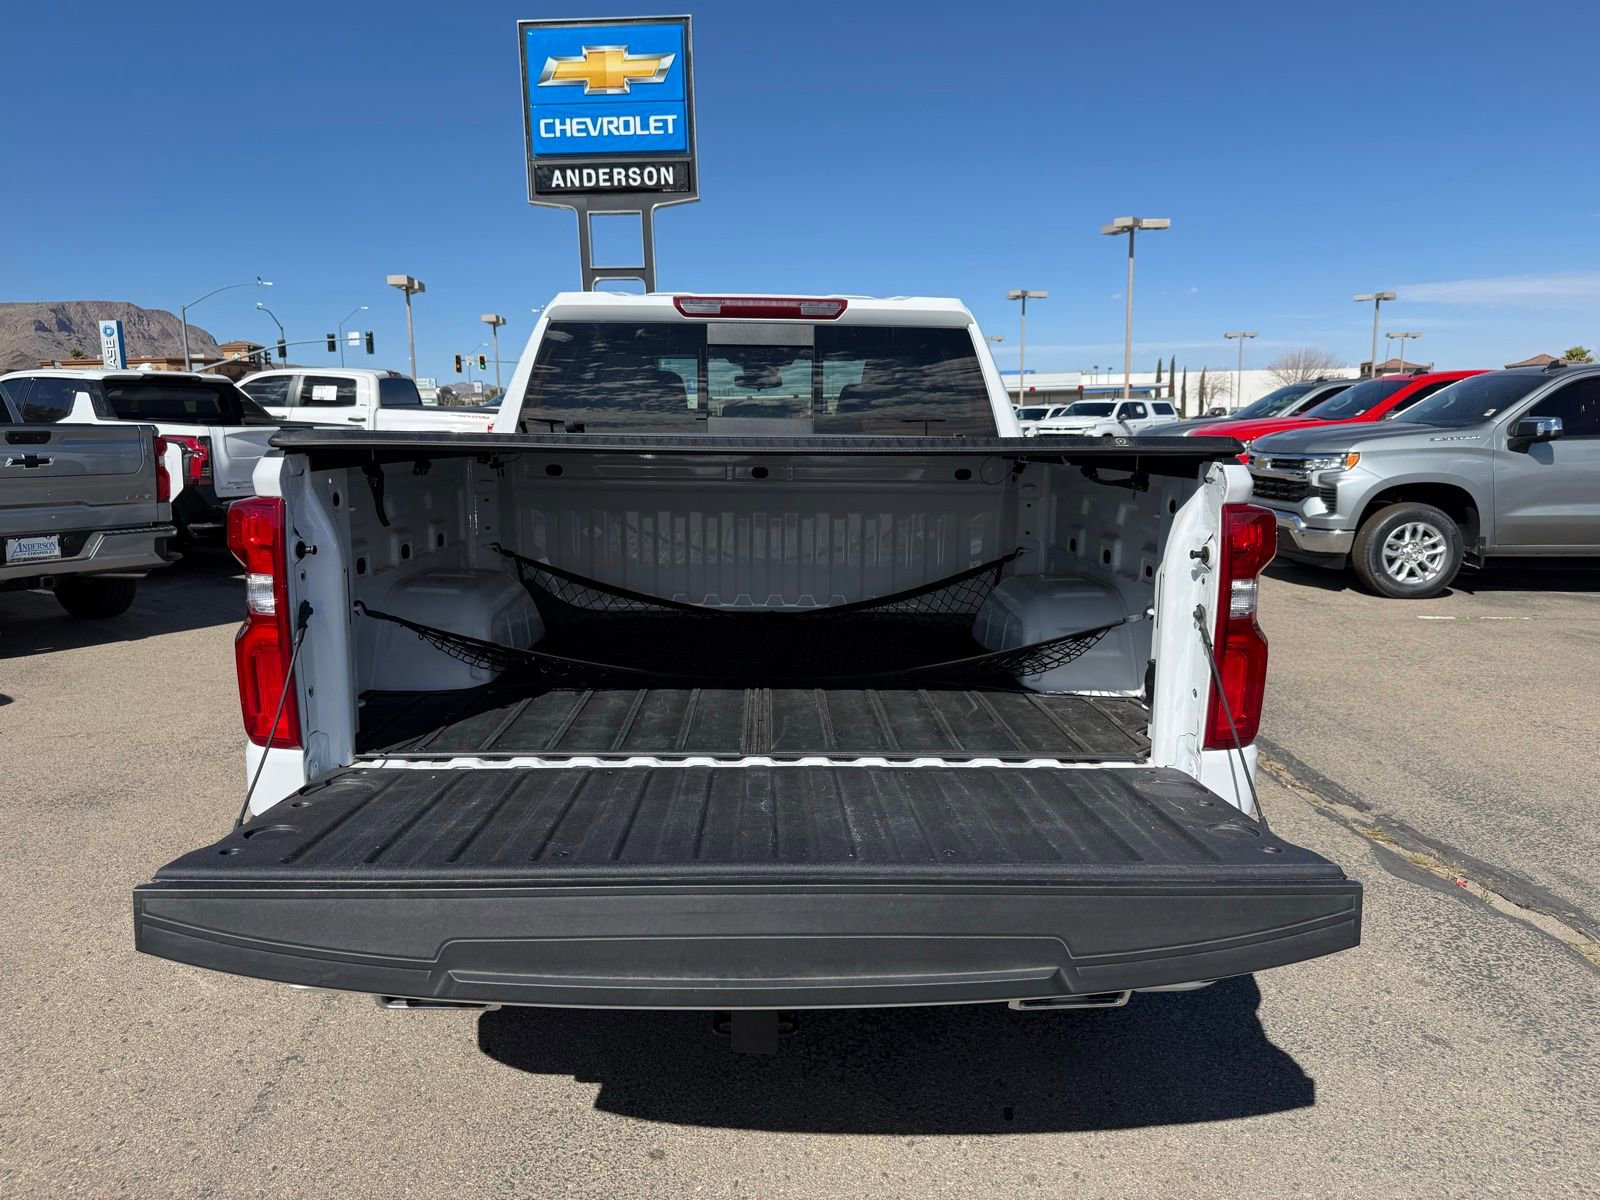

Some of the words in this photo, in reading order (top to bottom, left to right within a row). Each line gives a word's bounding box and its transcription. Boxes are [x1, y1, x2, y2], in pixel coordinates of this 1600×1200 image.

[539, 115, 677, 137] CHEVROLET
[551, 166, 674, 188] ANDERSON
[105, 339, 117, 369] ASE
